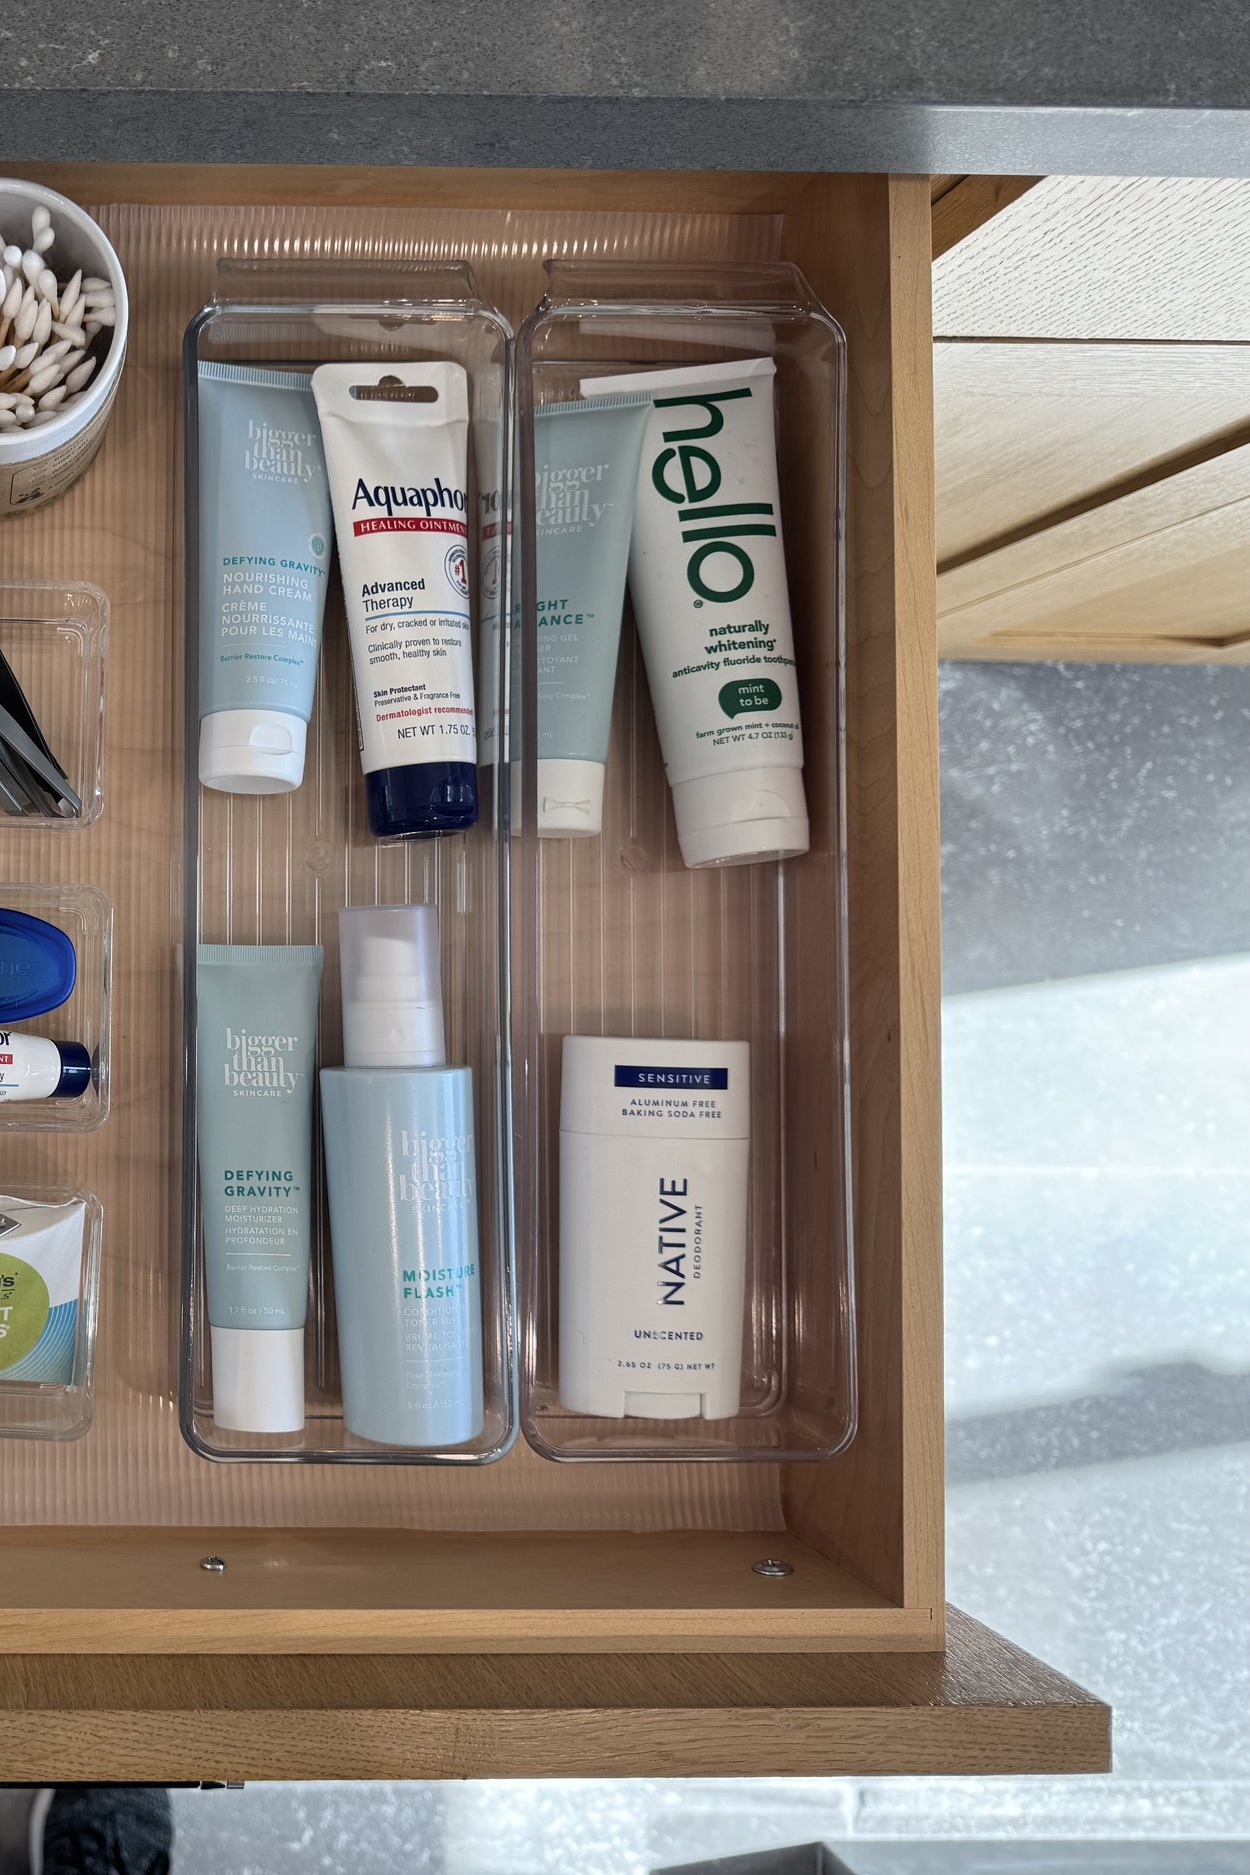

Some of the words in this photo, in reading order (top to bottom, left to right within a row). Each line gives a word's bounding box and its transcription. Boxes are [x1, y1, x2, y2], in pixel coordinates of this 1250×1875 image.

[248, 420, 317, 448] bigger
[254, 441, 302, 462] than
[245, 450, 317, 482] beauty
[252, 473, 298, 484] SKINCARE
[652, 387, 777, 603] hello
[361, 521, 415, 532] HEALING
[223, 557, 275, 566] DEFYING
[454, 559, 467, 584] #1
[223, 572, 308, 589] NOURISHING
[362, 578, 425, 597] Advanced
[223, 585, 263, 595] HAND
[269, 586, 311, 604] CREAM
[222, 600, 266, 613] CRÈME
[363, 596, 413, 612] Therapy
[222, 614, 314, 634] NOURRISSANTE
[366, 625, 377, 634] For
[398, 619, 427, 629] cracked
[709, 620, 769, 637] naturally
[222, 625, 256, 637] POUR
[263, 626, 283, 637] LES
[288, 630, 317, 648] MAINS
[368, 638, 402, 653] Clinically
[405, 637, 430, 649] proven
[433, 637, 440, 646] to
[442, 637, 462, 647] restore
[370, 651, 401, 665] smooth,
[402, 649, 430, 659] healthy
[433, 649, 447, 657] skin
[672, 661, 720, 678] anticavity
[723, 655, 761, 667] fluoride
[374, 689, 388, 698] Skin
[390, 684, 426, 694] Protectant
[738, 684, 764, 695] mint
[739, 697, 752, 706] to
[754, 696, 769, 705] be
[376, 707, 432, 722] Dermatologist
[397, 726, 416, 739] NET
[420, 724, 435, 735] WT
[440, 724, 458, 734] 1.75
[696, 731, 714, 739] farm
[717, 725, 743, 736] grown
[745, 722, 762, 730] mint
[712, 737, 730, 746] NET
[731, 734, 745, 743] WT
[226, 1027, 298, 1057] bigger
[233, 1051, 285, 1072] than
[224, 1064, 300, 1094] beauty
[638, 1073, 710, 1084] SENSITIVE
[630, 1099, 688, 1107] ALUMINUM
[692, 1100, 716, 1108] FREE
[622, 1109, 663, 1118] BAKING
[667, 1110, 695, 1118] SODA
[224, 1170, 293, 1181] DEFYING
[250, 1206, 298, 1214] HYDRATION
[225, 1215, 283, 1223] MOISTURIZER
[657, 1178, 688, 1306] NATIVE
[693, 1205, 703, 1279] DEODORANT
[403, 1264, 475, 1281] MOISTURE
[404, 1285, 454, 1298] FLASH
[634, 1329, 703, 1341] UNSCENTED
